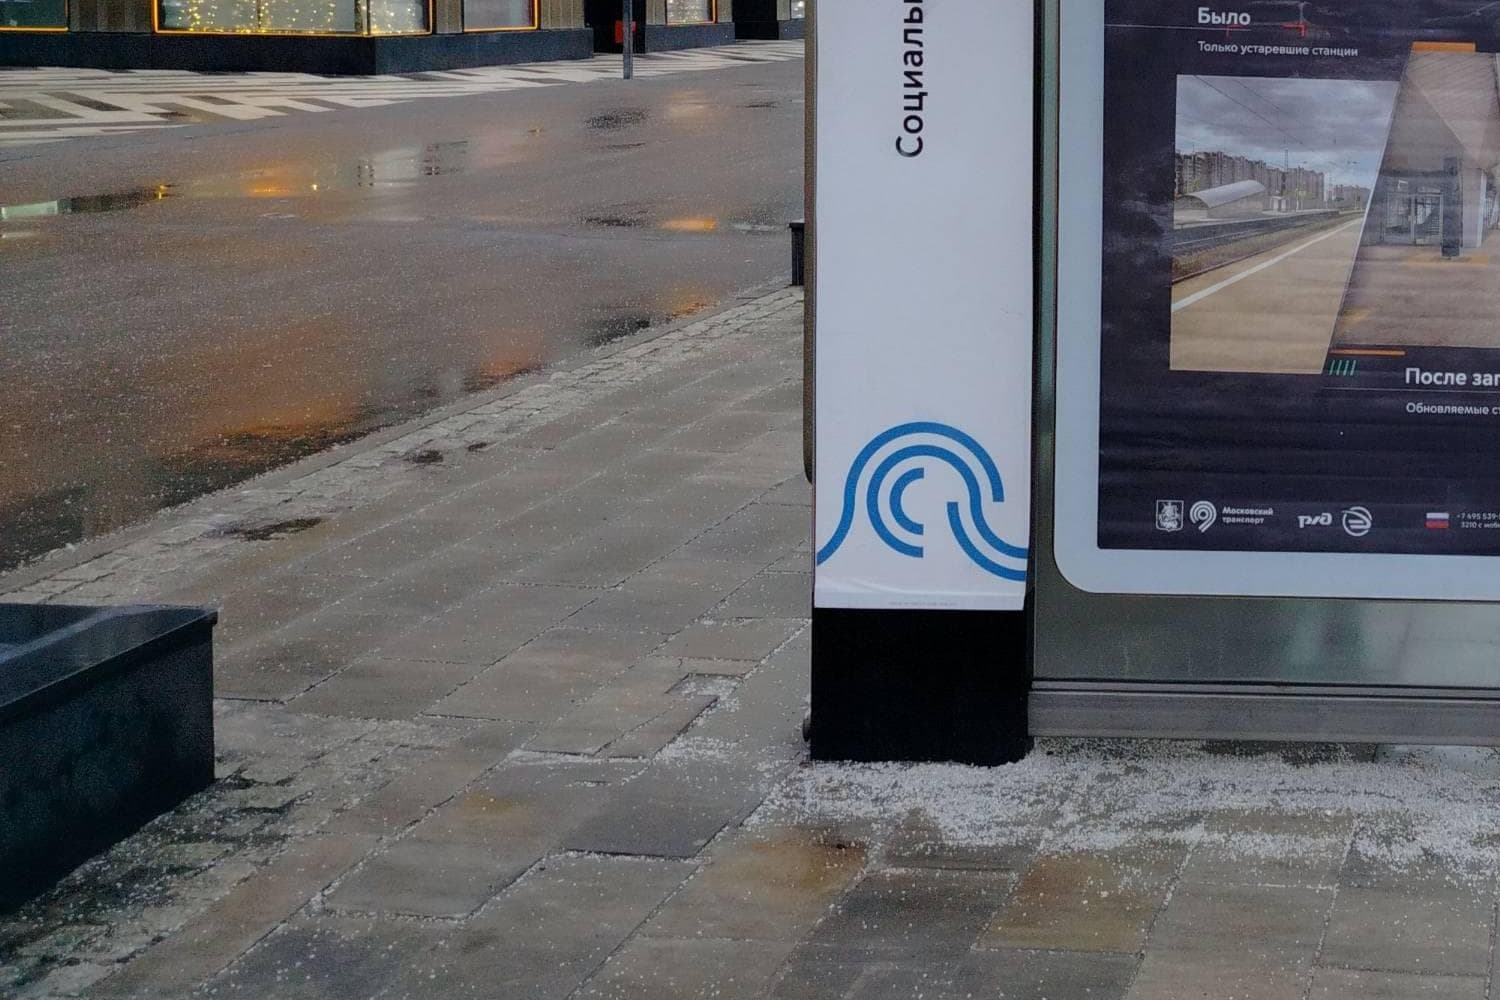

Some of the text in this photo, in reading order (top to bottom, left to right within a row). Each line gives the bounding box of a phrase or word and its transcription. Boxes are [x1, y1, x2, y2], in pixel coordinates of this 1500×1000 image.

[1198, 7, 1250, 25] Было
[1198, 41, 1358, 58] Только устаревшие станции
[1405, 367, 1467, 385] После
[1406, 402, 1489, 415] Обновляемые
[1222, 506, 1274, 516] Московский
[1222, 516, 1264, 525] транспорт
